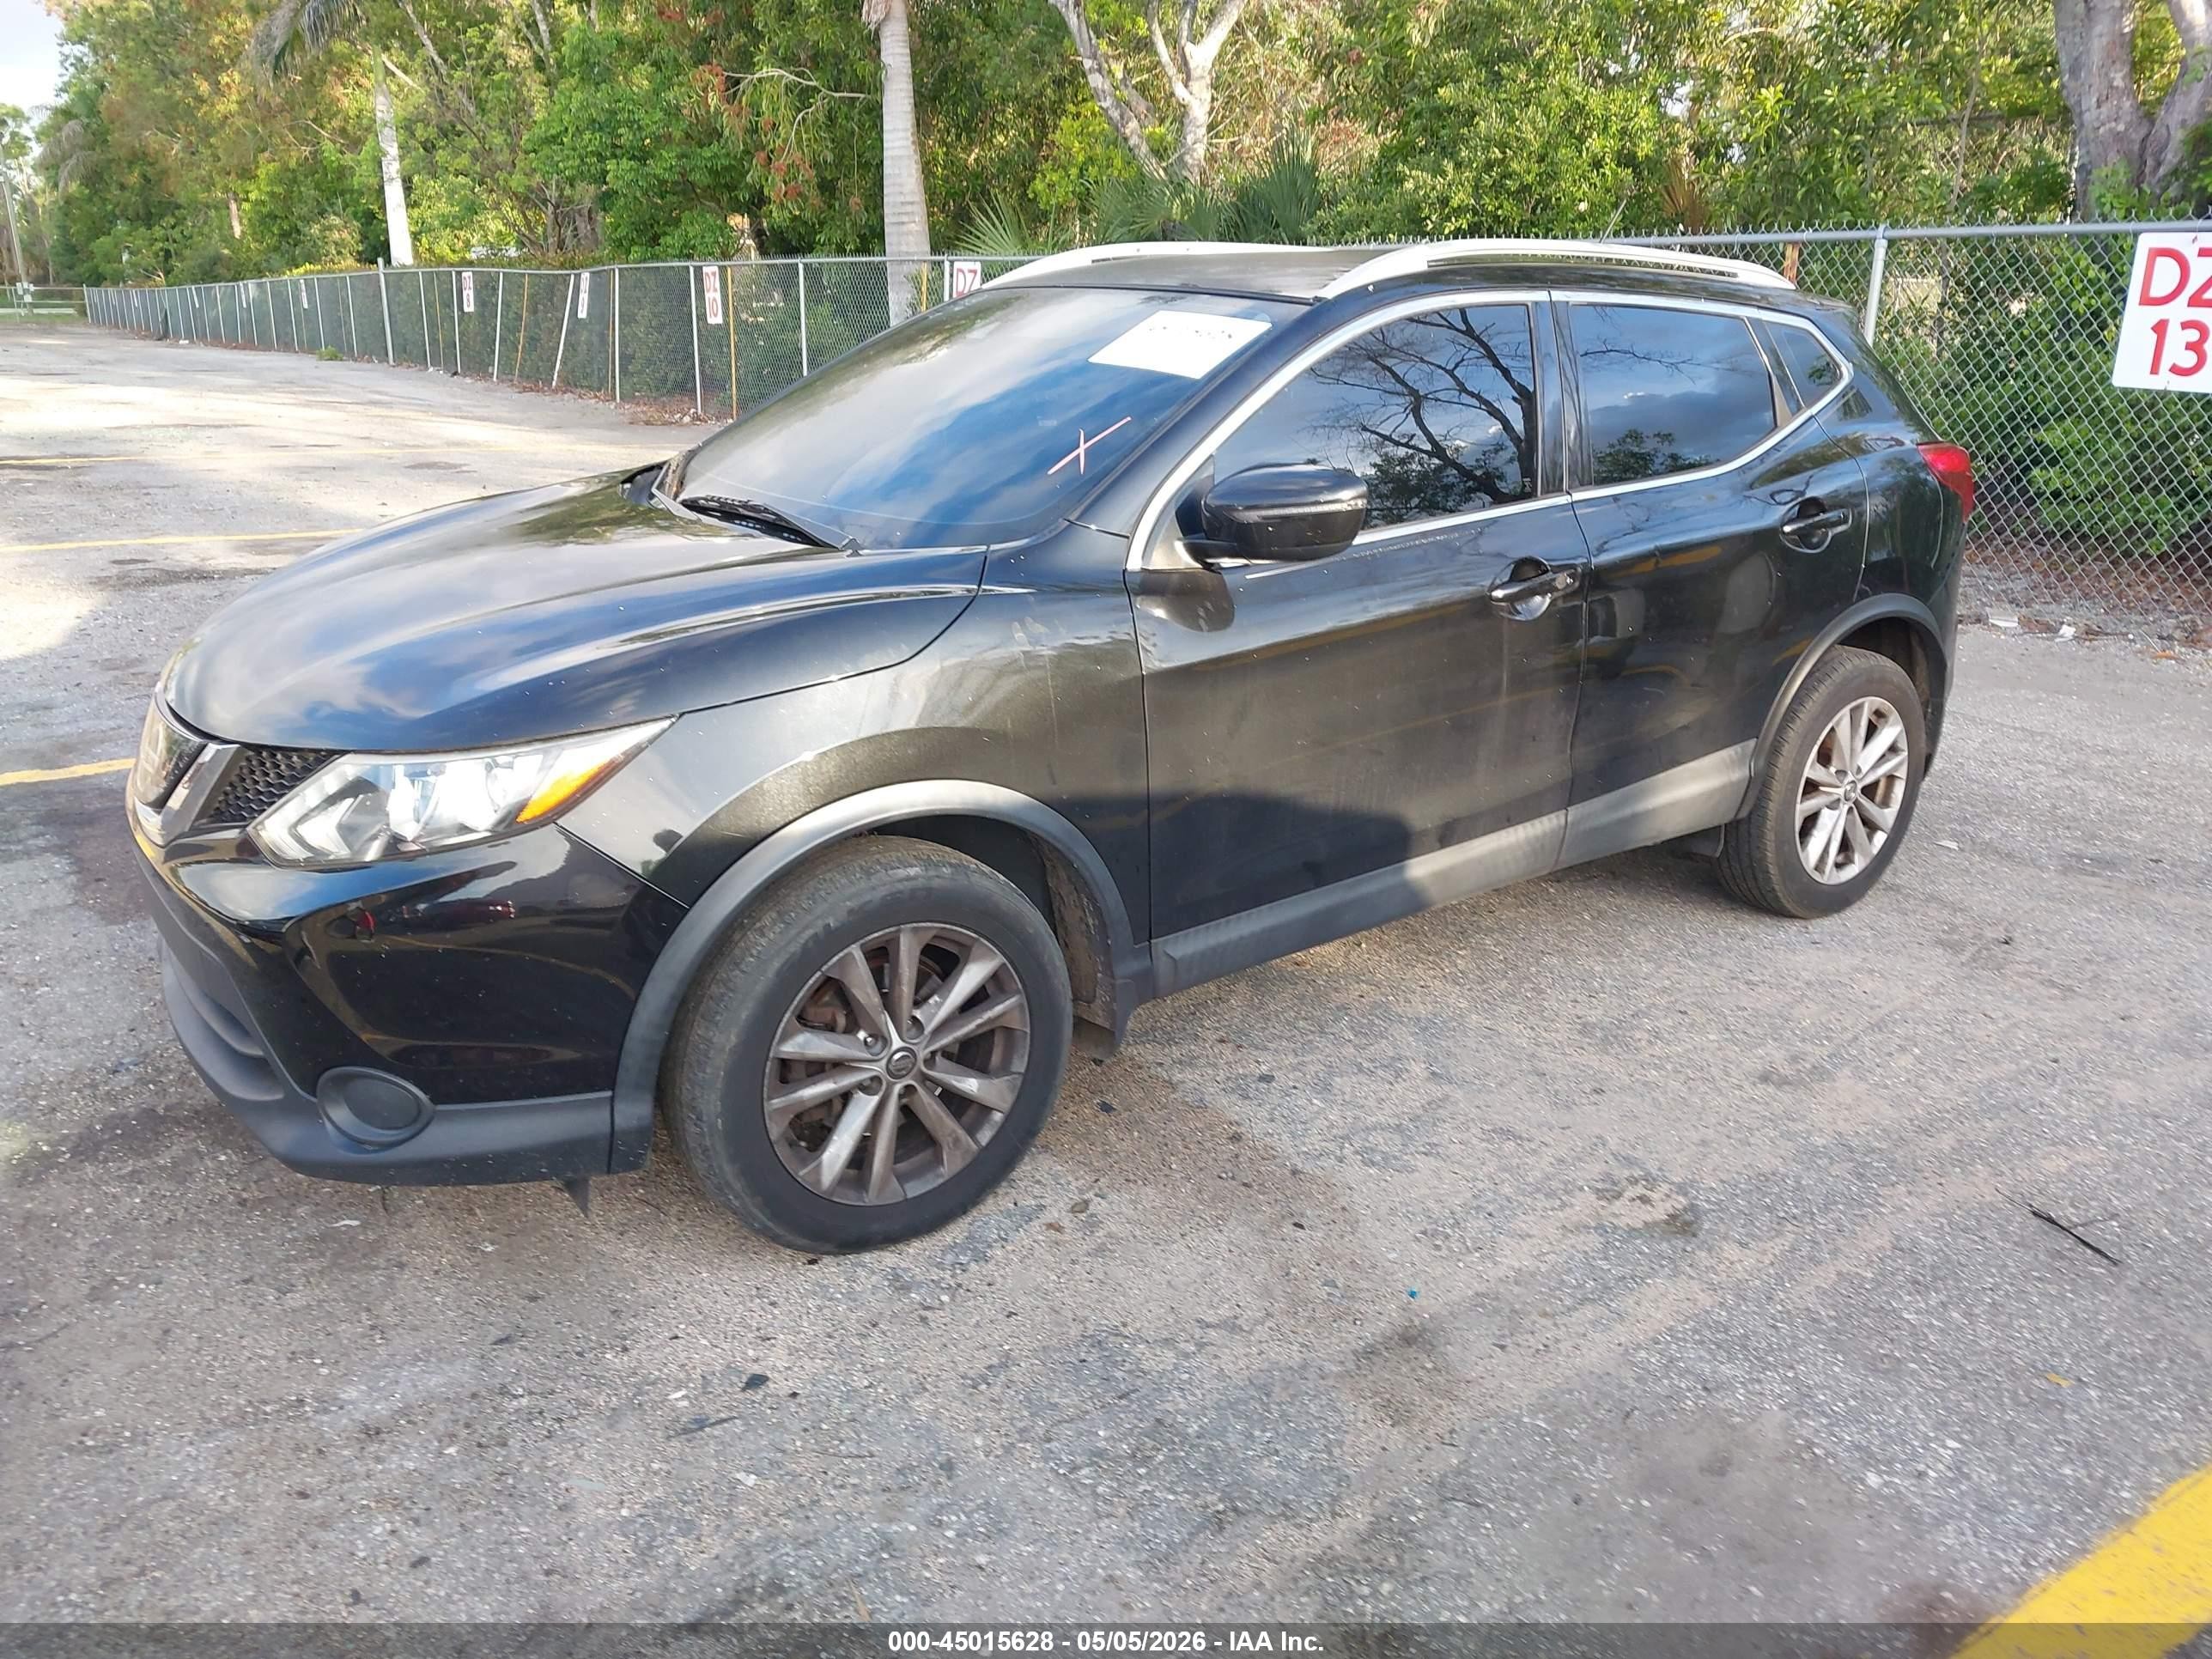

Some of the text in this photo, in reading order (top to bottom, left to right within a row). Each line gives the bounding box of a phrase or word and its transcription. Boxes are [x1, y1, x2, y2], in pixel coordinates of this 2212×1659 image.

[463, 275, 471, 291] DZ
[704, 270, 718, 293] DZ
[708, 296, 719, 319] 10
[2149, 318, 2211, 377] 13
